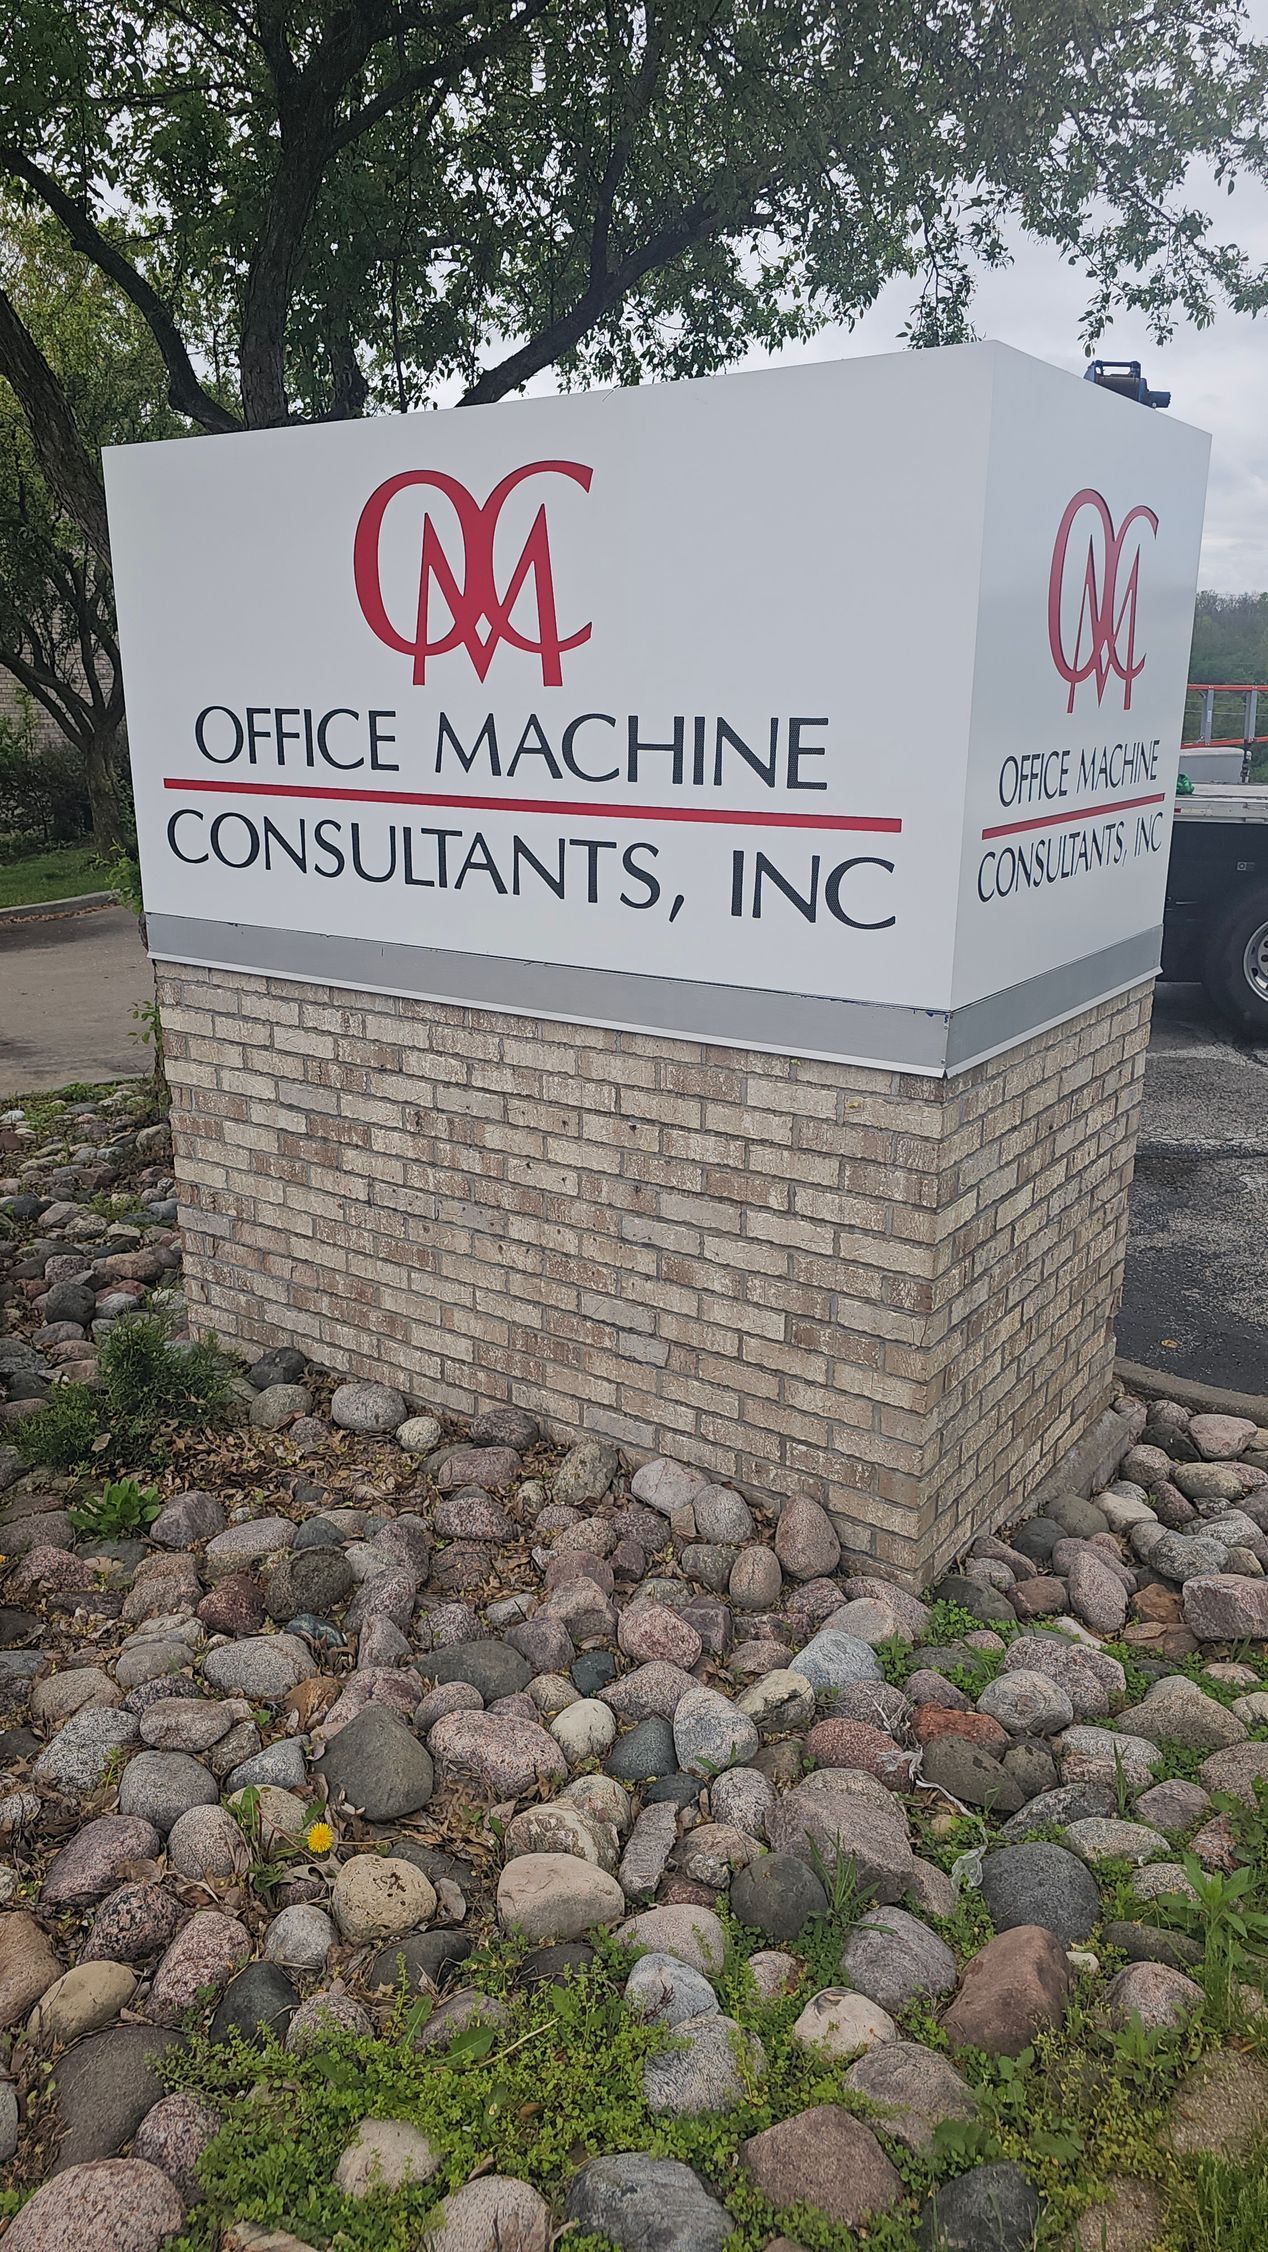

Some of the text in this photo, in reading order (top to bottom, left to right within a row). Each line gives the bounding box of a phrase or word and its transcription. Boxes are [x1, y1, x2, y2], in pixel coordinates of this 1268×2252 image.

[194, 705, 830, 792] OFFICE MACHINE
[999, 740, 1160, 807] OFFICE MACHINE
[166, 808, 897, 931] CONSULTANTS, INC
[977, 811, 1164, 903] CONSULTANTS, INC
